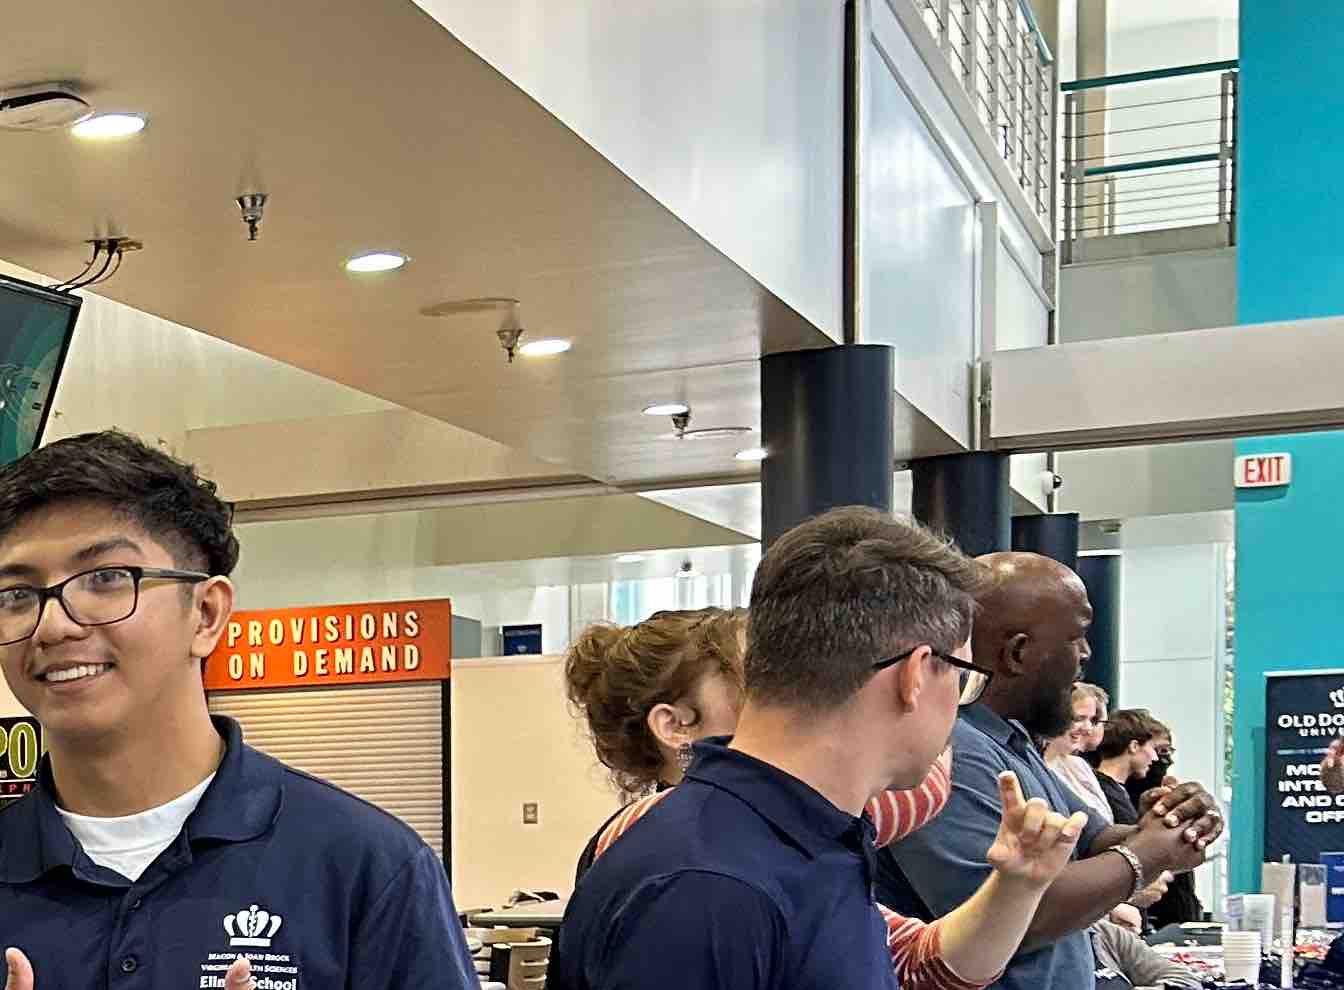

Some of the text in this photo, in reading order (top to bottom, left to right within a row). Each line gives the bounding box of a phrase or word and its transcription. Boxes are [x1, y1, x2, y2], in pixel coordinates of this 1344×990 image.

[1243, 456, 1284, 483] EXIT
[228, 611, 420, 648] PROVISIONS
[229, 644, 420, 680] ON DEMAND
[1278, 714, 1316, 728] OLD
[1282, 795, 1331, 807] AND
